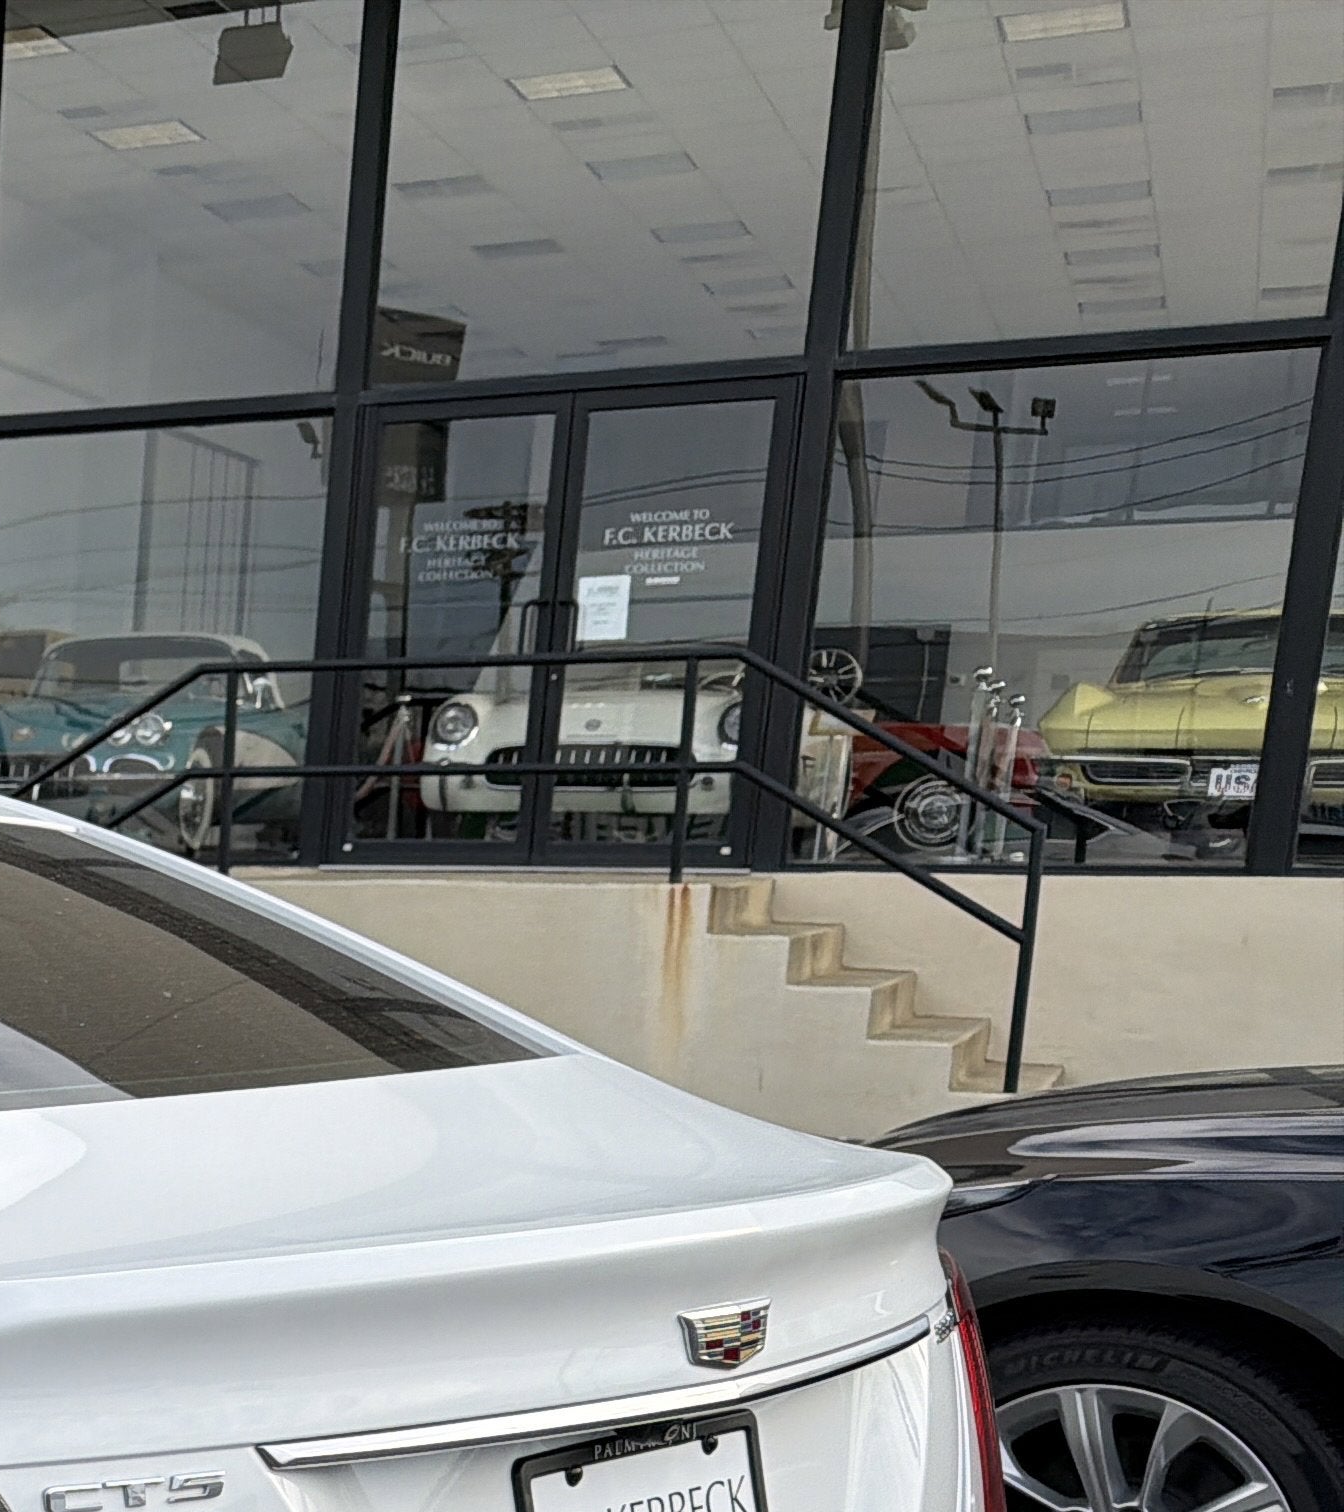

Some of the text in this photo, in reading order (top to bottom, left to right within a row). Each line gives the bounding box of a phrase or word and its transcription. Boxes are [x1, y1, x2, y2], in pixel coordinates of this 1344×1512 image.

[630, 508, 710, 523] WELCOME TO
[436, 533, 520, 551] KERBECK
[603, 522, 735, 546] F.C. KERBECK
[633, 547, 700, 560] HERITAGE
[624, 561, 706, 574] COLLECTION
[1215, 774, 1256, 793] US
